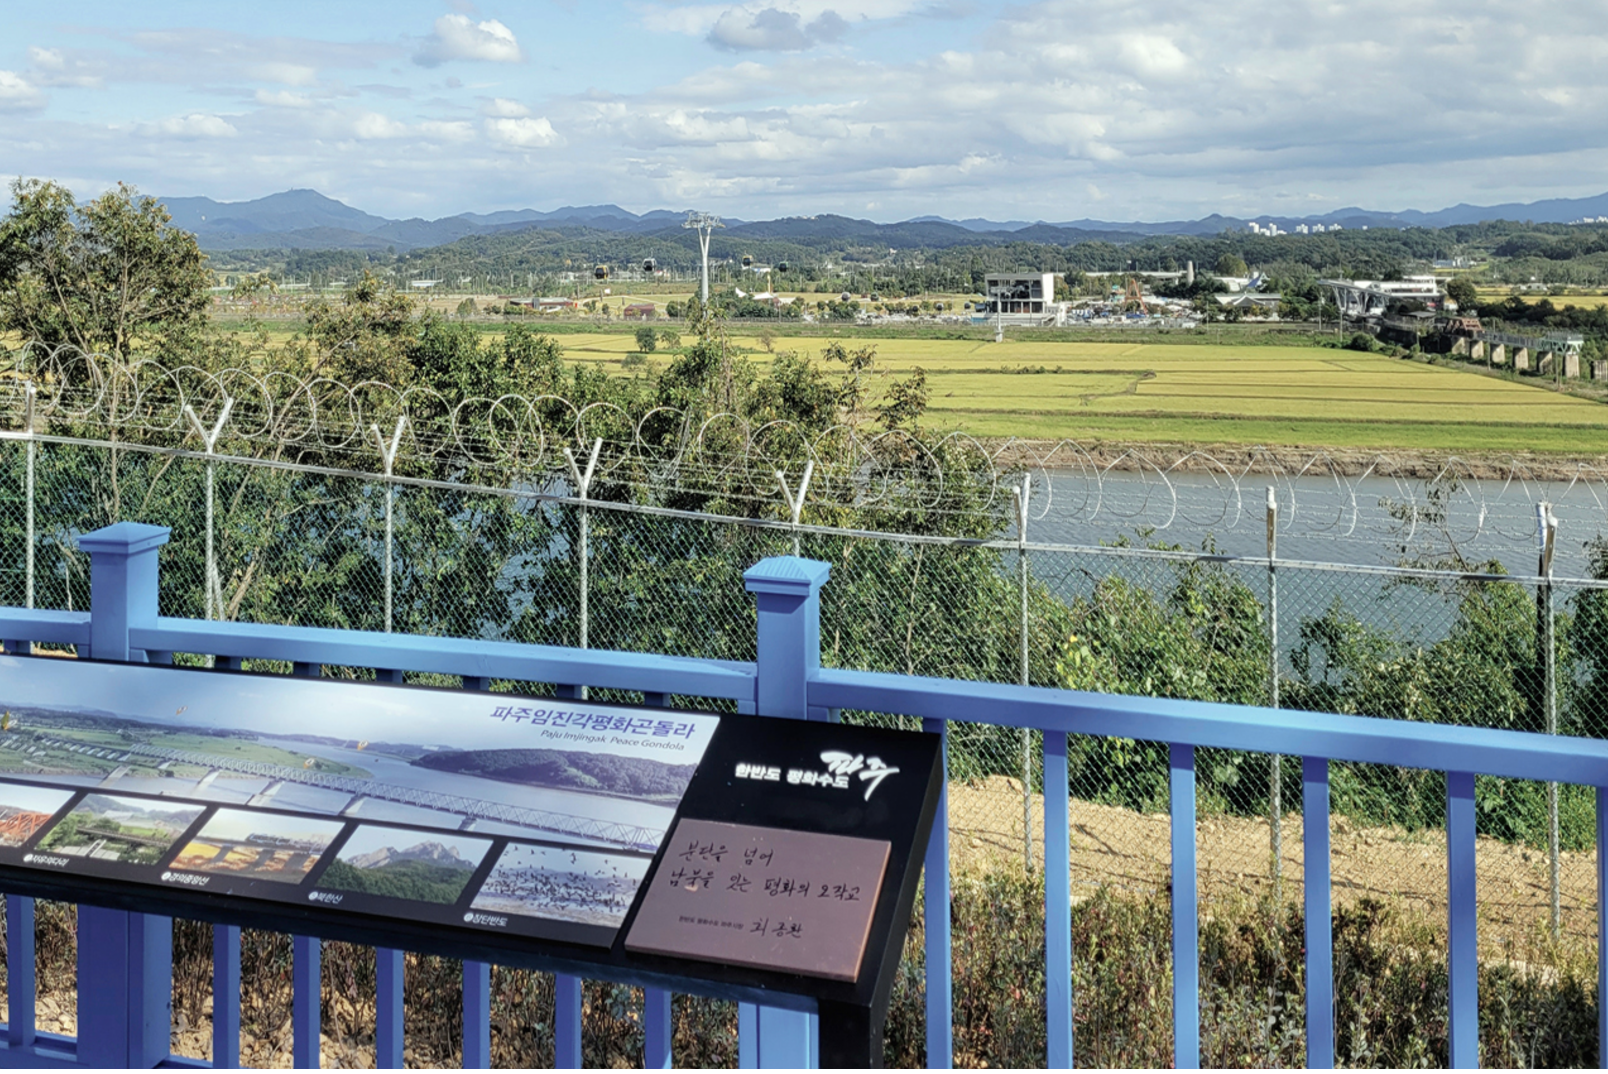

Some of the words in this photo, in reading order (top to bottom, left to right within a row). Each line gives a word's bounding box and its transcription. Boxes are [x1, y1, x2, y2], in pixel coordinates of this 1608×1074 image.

[489, 705, 697, 740] 파주임진각평화곤돌라
[540, 729, 563, 740] Paju
[564, 731, 607, 744] Imjingak
[610, 737, 640, 747] Peace
[641, 739, 685, 751] Gondola
[735, 762, 781, 782] 한반도
[786, 769, 850, 789] 평화수도
[764, 877, 810, 897] 평화의
[817, 883, 860, 901] 오작교
